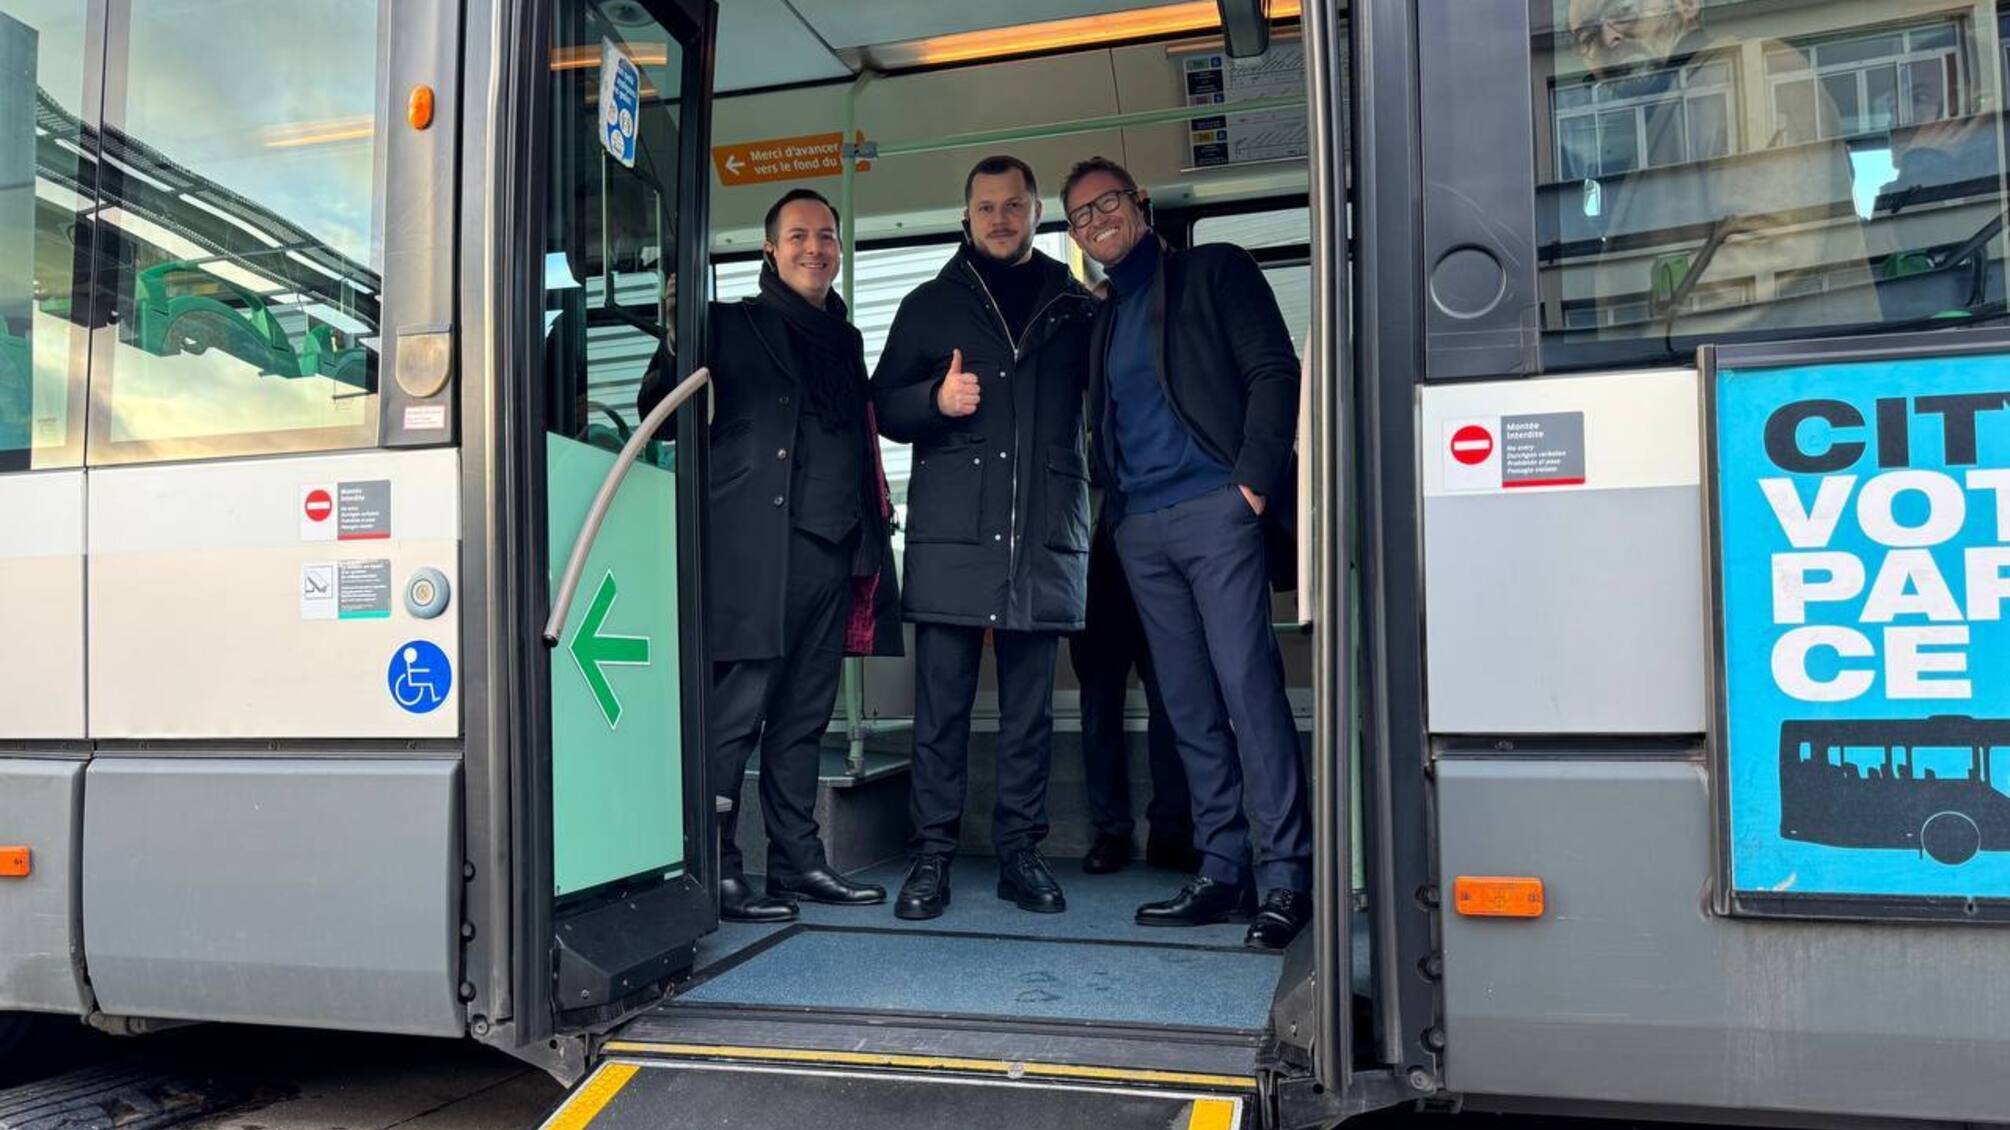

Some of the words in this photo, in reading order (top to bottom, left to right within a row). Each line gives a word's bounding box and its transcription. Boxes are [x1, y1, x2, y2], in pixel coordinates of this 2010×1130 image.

[750, 148, 782, 162] Merci
[785, 143, 839, 158] d'avancer
[754, 163, 779, 175] vers
[780, 160, 791, 172] le
[793, 158, 820, 171] fond
[822, 157, 838, 168] du
[1763, 391, 2010, 474] CIT
[1771, 624, 1972, 702] CE
